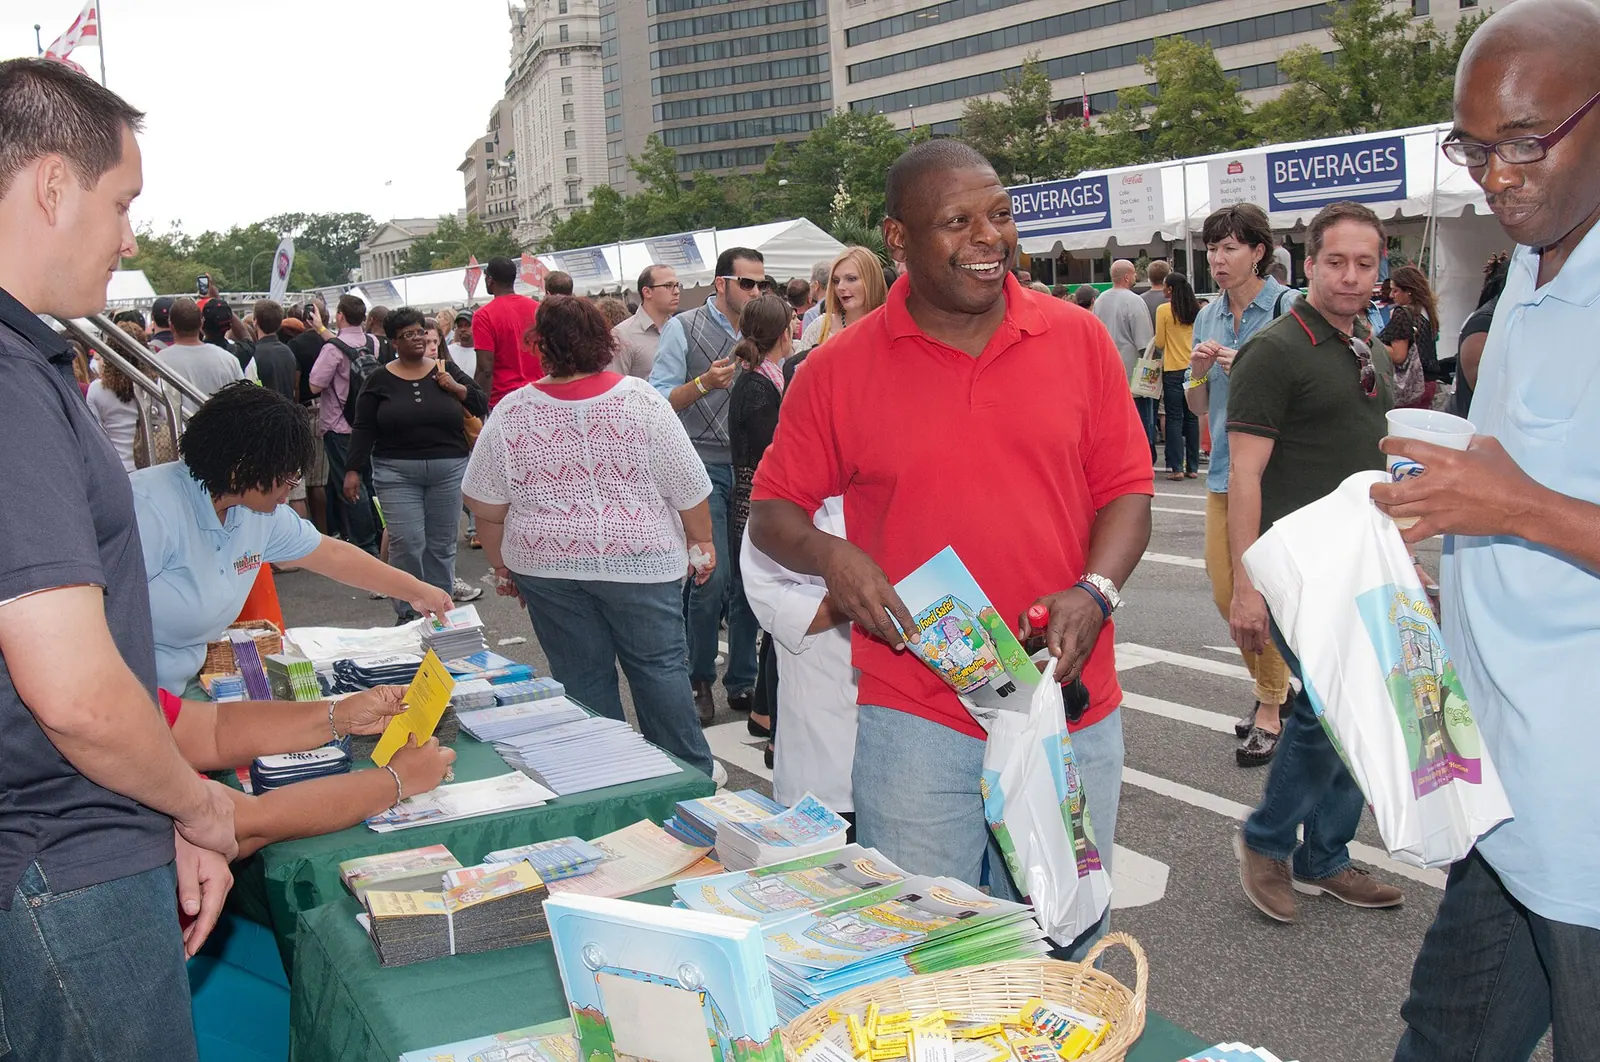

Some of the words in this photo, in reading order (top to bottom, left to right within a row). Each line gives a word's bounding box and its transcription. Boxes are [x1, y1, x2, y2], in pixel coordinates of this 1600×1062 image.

[1274, 146, 1399, 184] BEVERAGES
[1220, 177, 1232, 185] Stella
[1230, 187, 1241, 195] Light
[1011, 183, 1104, 215] BEVERAGES
[1119, 189, 1130, 197] Coke
[919, 610, 938, 632] Food
[935, 596, 955, 619] Safe!
